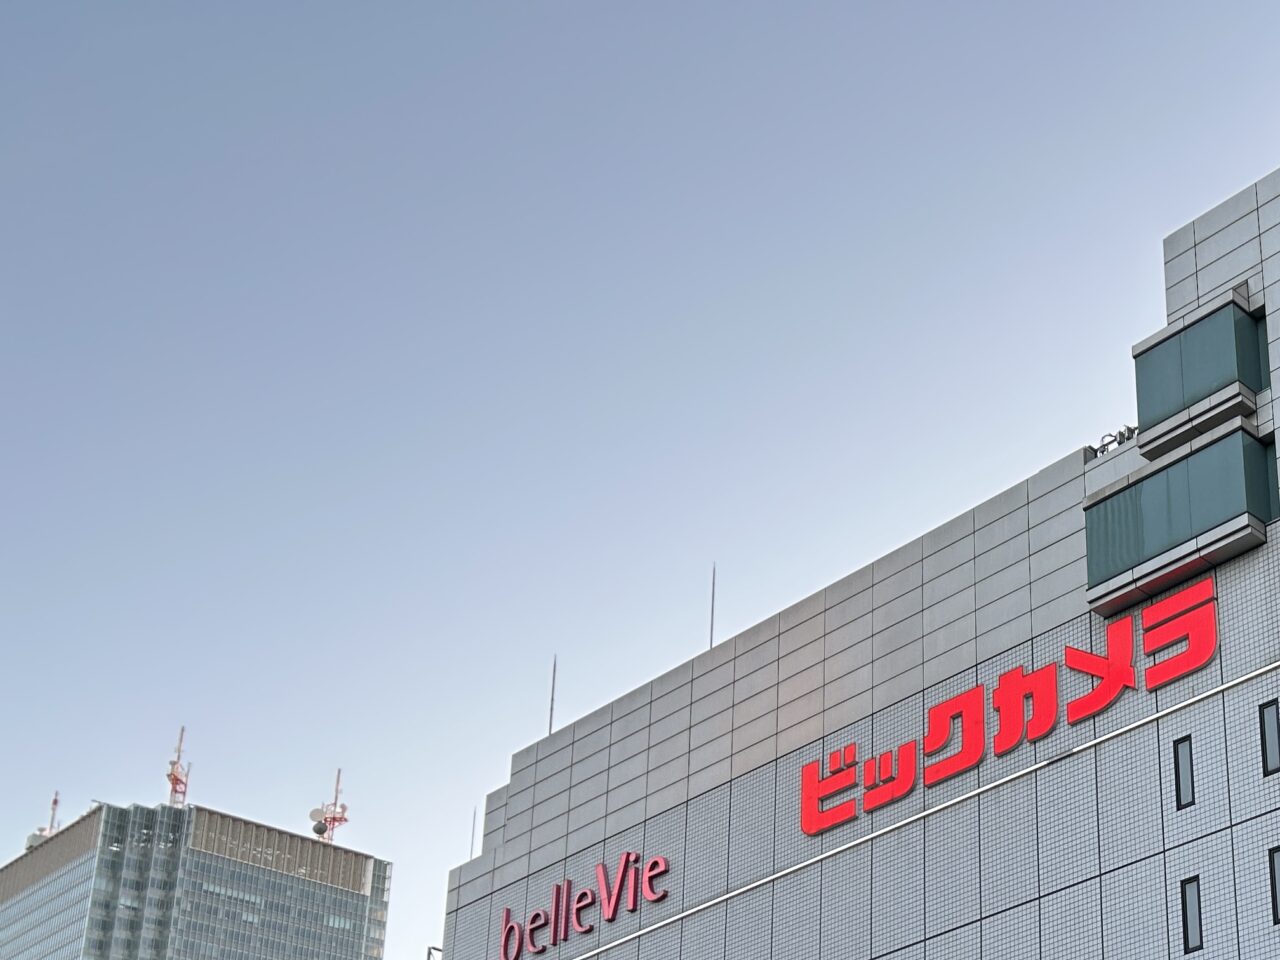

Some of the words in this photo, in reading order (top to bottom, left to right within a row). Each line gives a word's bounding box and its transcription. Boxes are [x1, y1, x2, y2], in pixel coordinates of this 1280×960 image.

[801, 576, 1219, 837] ビックカメラ
